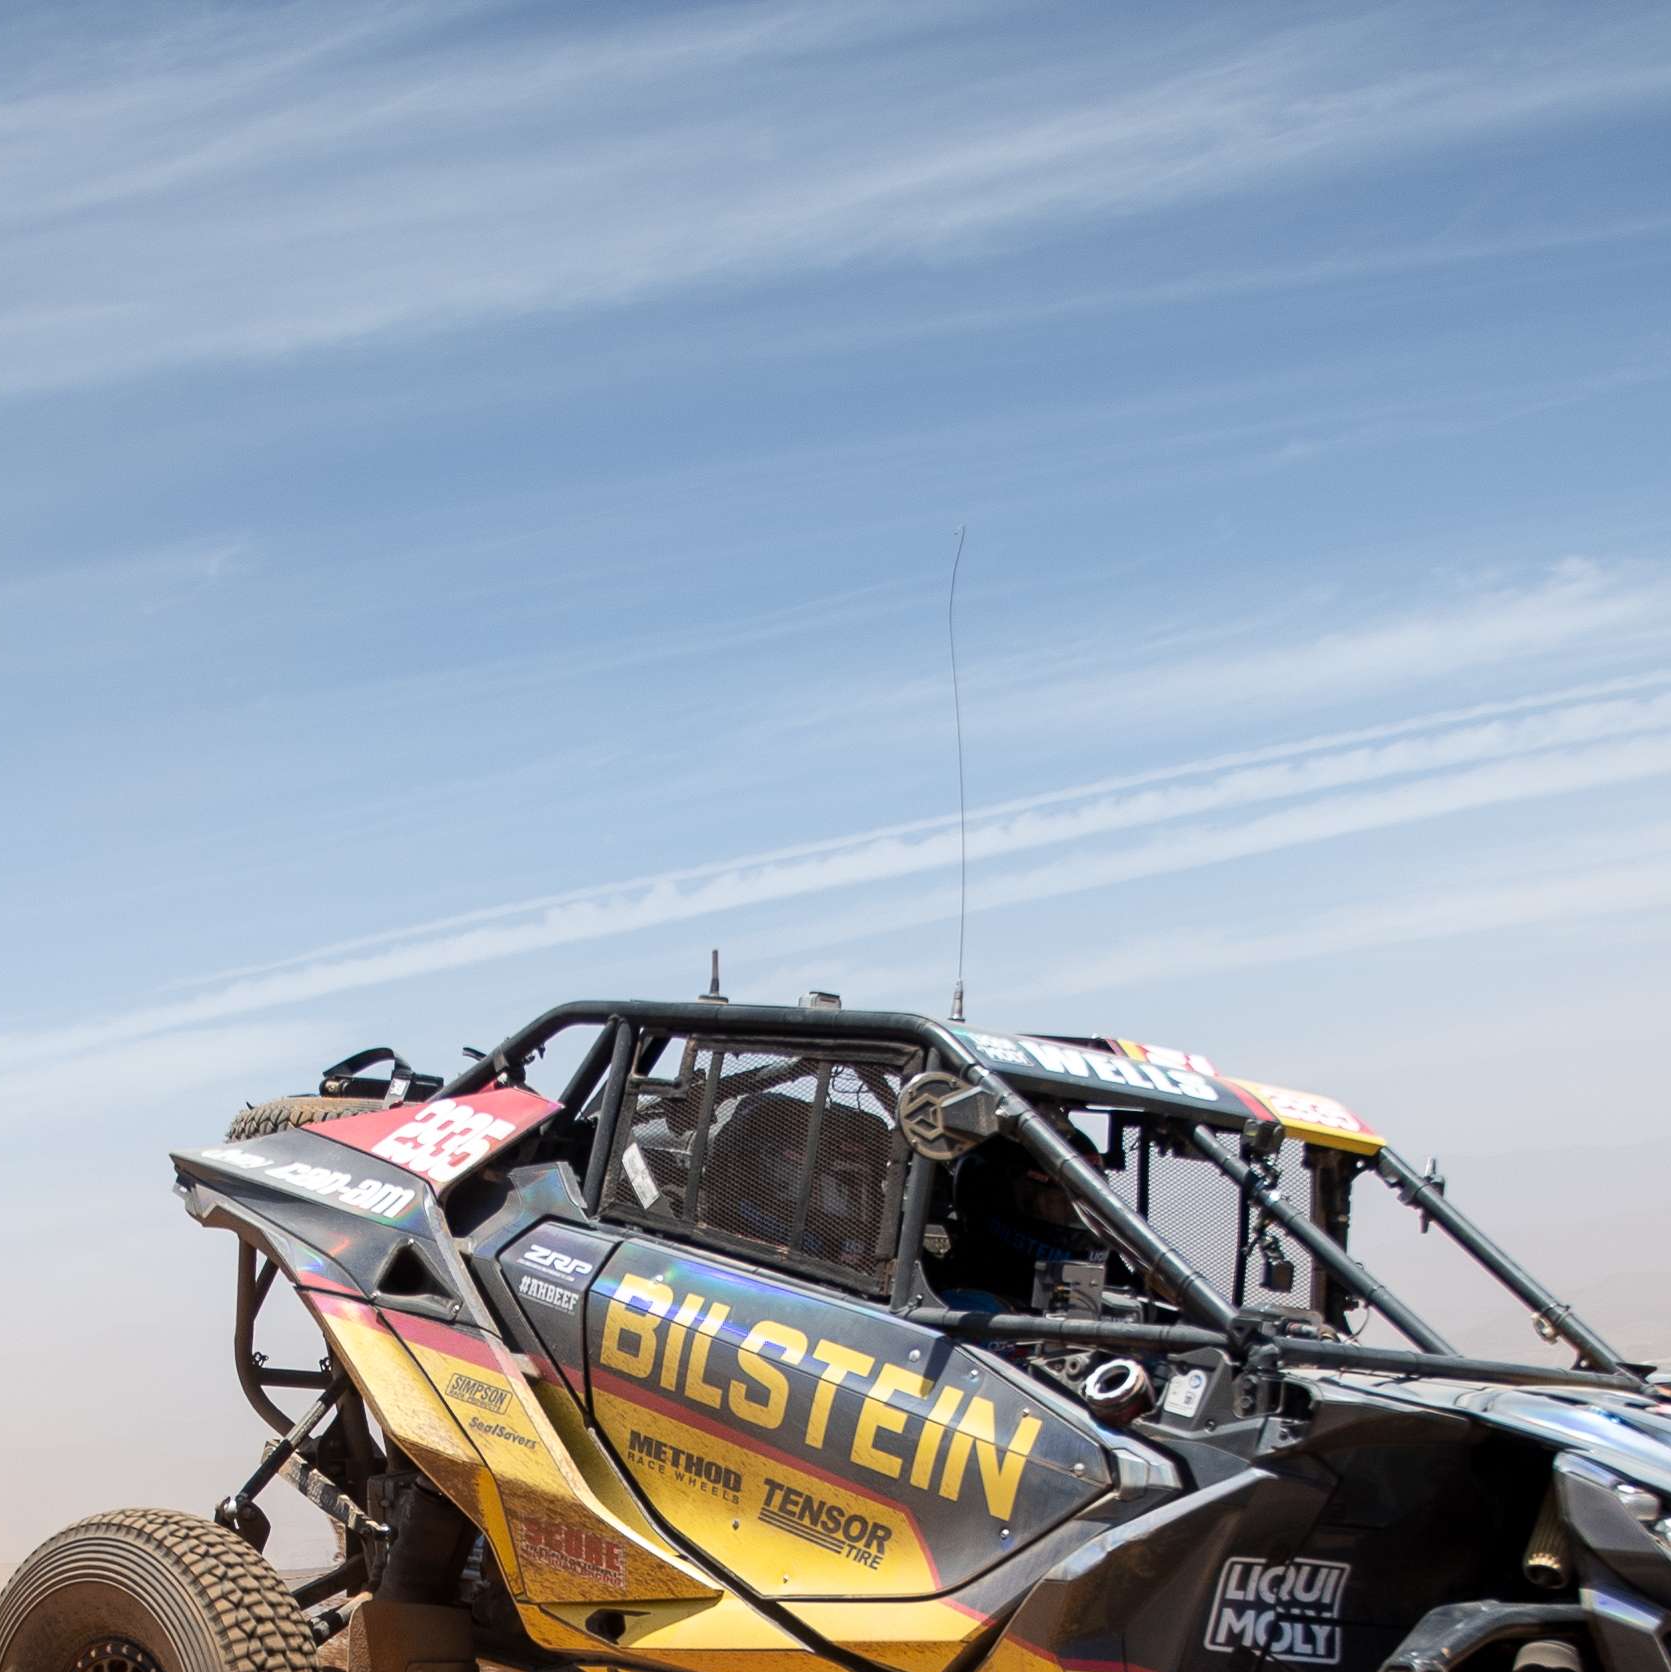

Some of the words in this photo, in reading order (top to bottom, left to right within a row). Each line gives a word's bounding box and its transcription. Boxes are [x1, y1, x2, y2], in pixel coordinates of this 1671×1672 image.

[1017, 1040, 1219, 1101] WELLS
[371, 1099, 516, 1183] 2935
[523, 1244, 593, 1275] ZRP
[518, 1275, 580, 1311] #AHBEEF
[450, 1376, 508, 1407] SIMPSON
[599, 1272, 1044, 1521] BILSTEIN
[468, 1416, 537, 1450] SealSavers
[627, 1452, 666, 1475] RACE
[674, 1470, 740, 1505] WHEELS
[628, 1429, 743, 1494] METHOD
[763, 1478, 893, 1555] TENSOR
[844, 1542, 884, 1571] TIRE
[1224, 1563, 1342, 1604] LIQUI
[1214, 1607, 1333, 1656] MOLY
